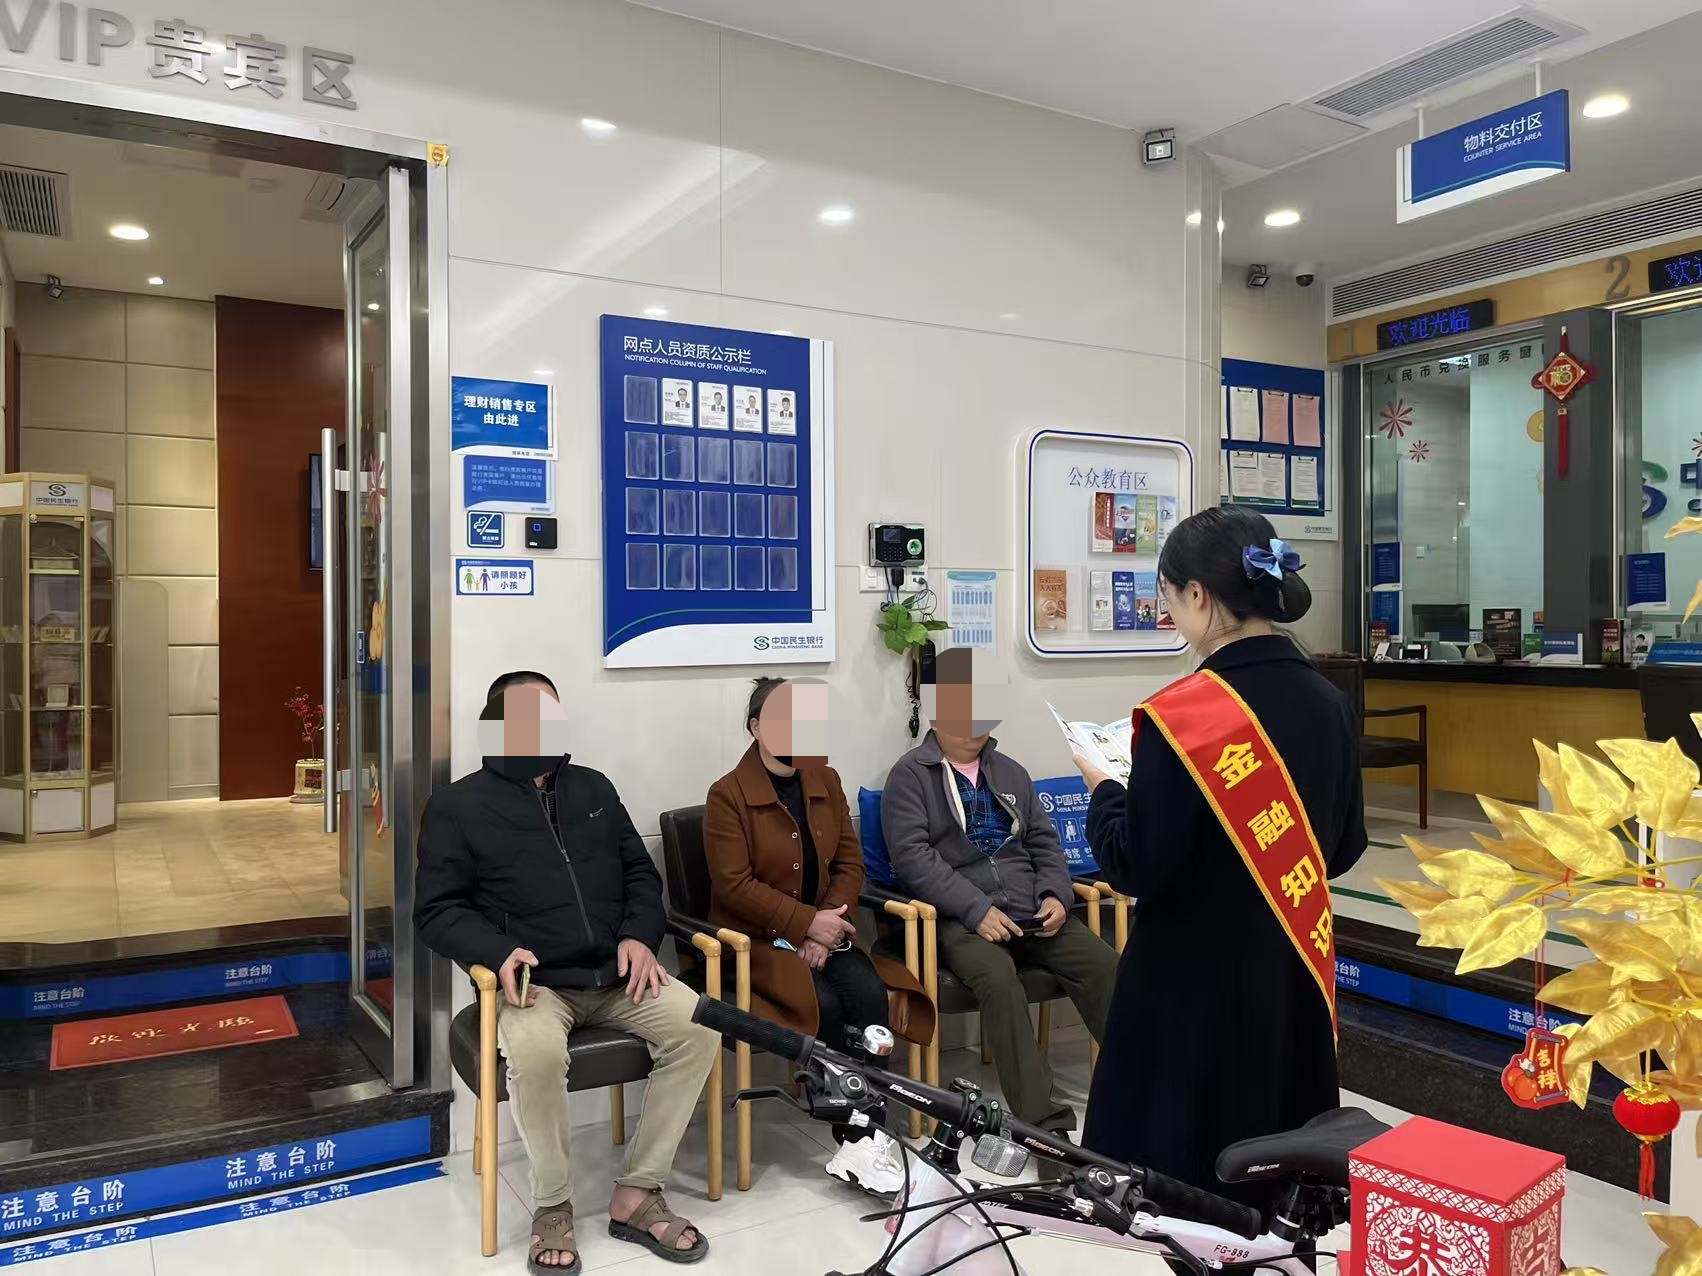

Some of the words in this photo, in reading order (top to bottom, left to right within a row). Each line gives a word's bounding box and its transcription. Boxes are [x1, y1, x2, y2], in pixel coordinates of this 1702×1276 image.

[1463, 111, 1543, 153] 物料交付区
[1463, 147, 1494, 162] COUNTER
[1495, 137, 1522, 152] SERVICE
[1523, 131, 1542, 143] AREA
[1605, 255, 1631, 301] 2
[1387, 306, 1473, 346] 欢迎光临
[623, 335, 752, 365] 网点人员资质公示栏
[1384, 342, 1544, 385] 人民币兑换服务窗
[624, 354, 669, 365] NOTIFICATION
[670, 359, 697, 368] COLUMN
[707, 363, 723, 371] STAFF
[723, 365, 767, 375] QUALIFICATION
[1549, 364, 1573, 387] 福
[463, 395, 537, 413] 理财销售专区
[483, 412, 520, 426] 由此进
[1067, 466, 1149, 491] 公众教育区
[490, 570, 527, 580] 请照顾好
[500, 581, 518, 590] 小孩
[771, 636, 824, 645] 中国民生银行
[224, 964, 273, 980] 注意台阶
[1345, 977, 1360, 986] STEP
[34, 987, 85, 1002] 注意台阶
[1508, 1022, 1529, 1035] MIND
[1537, 1048, 1557, 1089] 吉祥
[225, 1139, 337, 1178] 注意台阶
[227, 1175, 262, 1190] MIND
[271, 1169, 295, 1181] THE
[303, 1161, 335, 1174] STEP
[0, 1179, 125, 1219] 注意台阶
[240, 1183, 350, 1213] 注意台阶
[242, 1207, 278, 1217] MIND
[287, 1200, 311, 1208] THE
[320, 1191, 351, 1201] STEP
[3, 1216, 42, 1231] MIND
[52, 1210, 80, 1222] THE
[89, 1202, 124, 1216] STEP
[13, 1226, 138, 1258] 注意台阶
[14, 1251, 54, 1263] MIND
[64, 1243, 91, 1252] THE
[102, 1235, 137, 1245] STEP
[1213, 1244, 1250, 1259] FG-888
